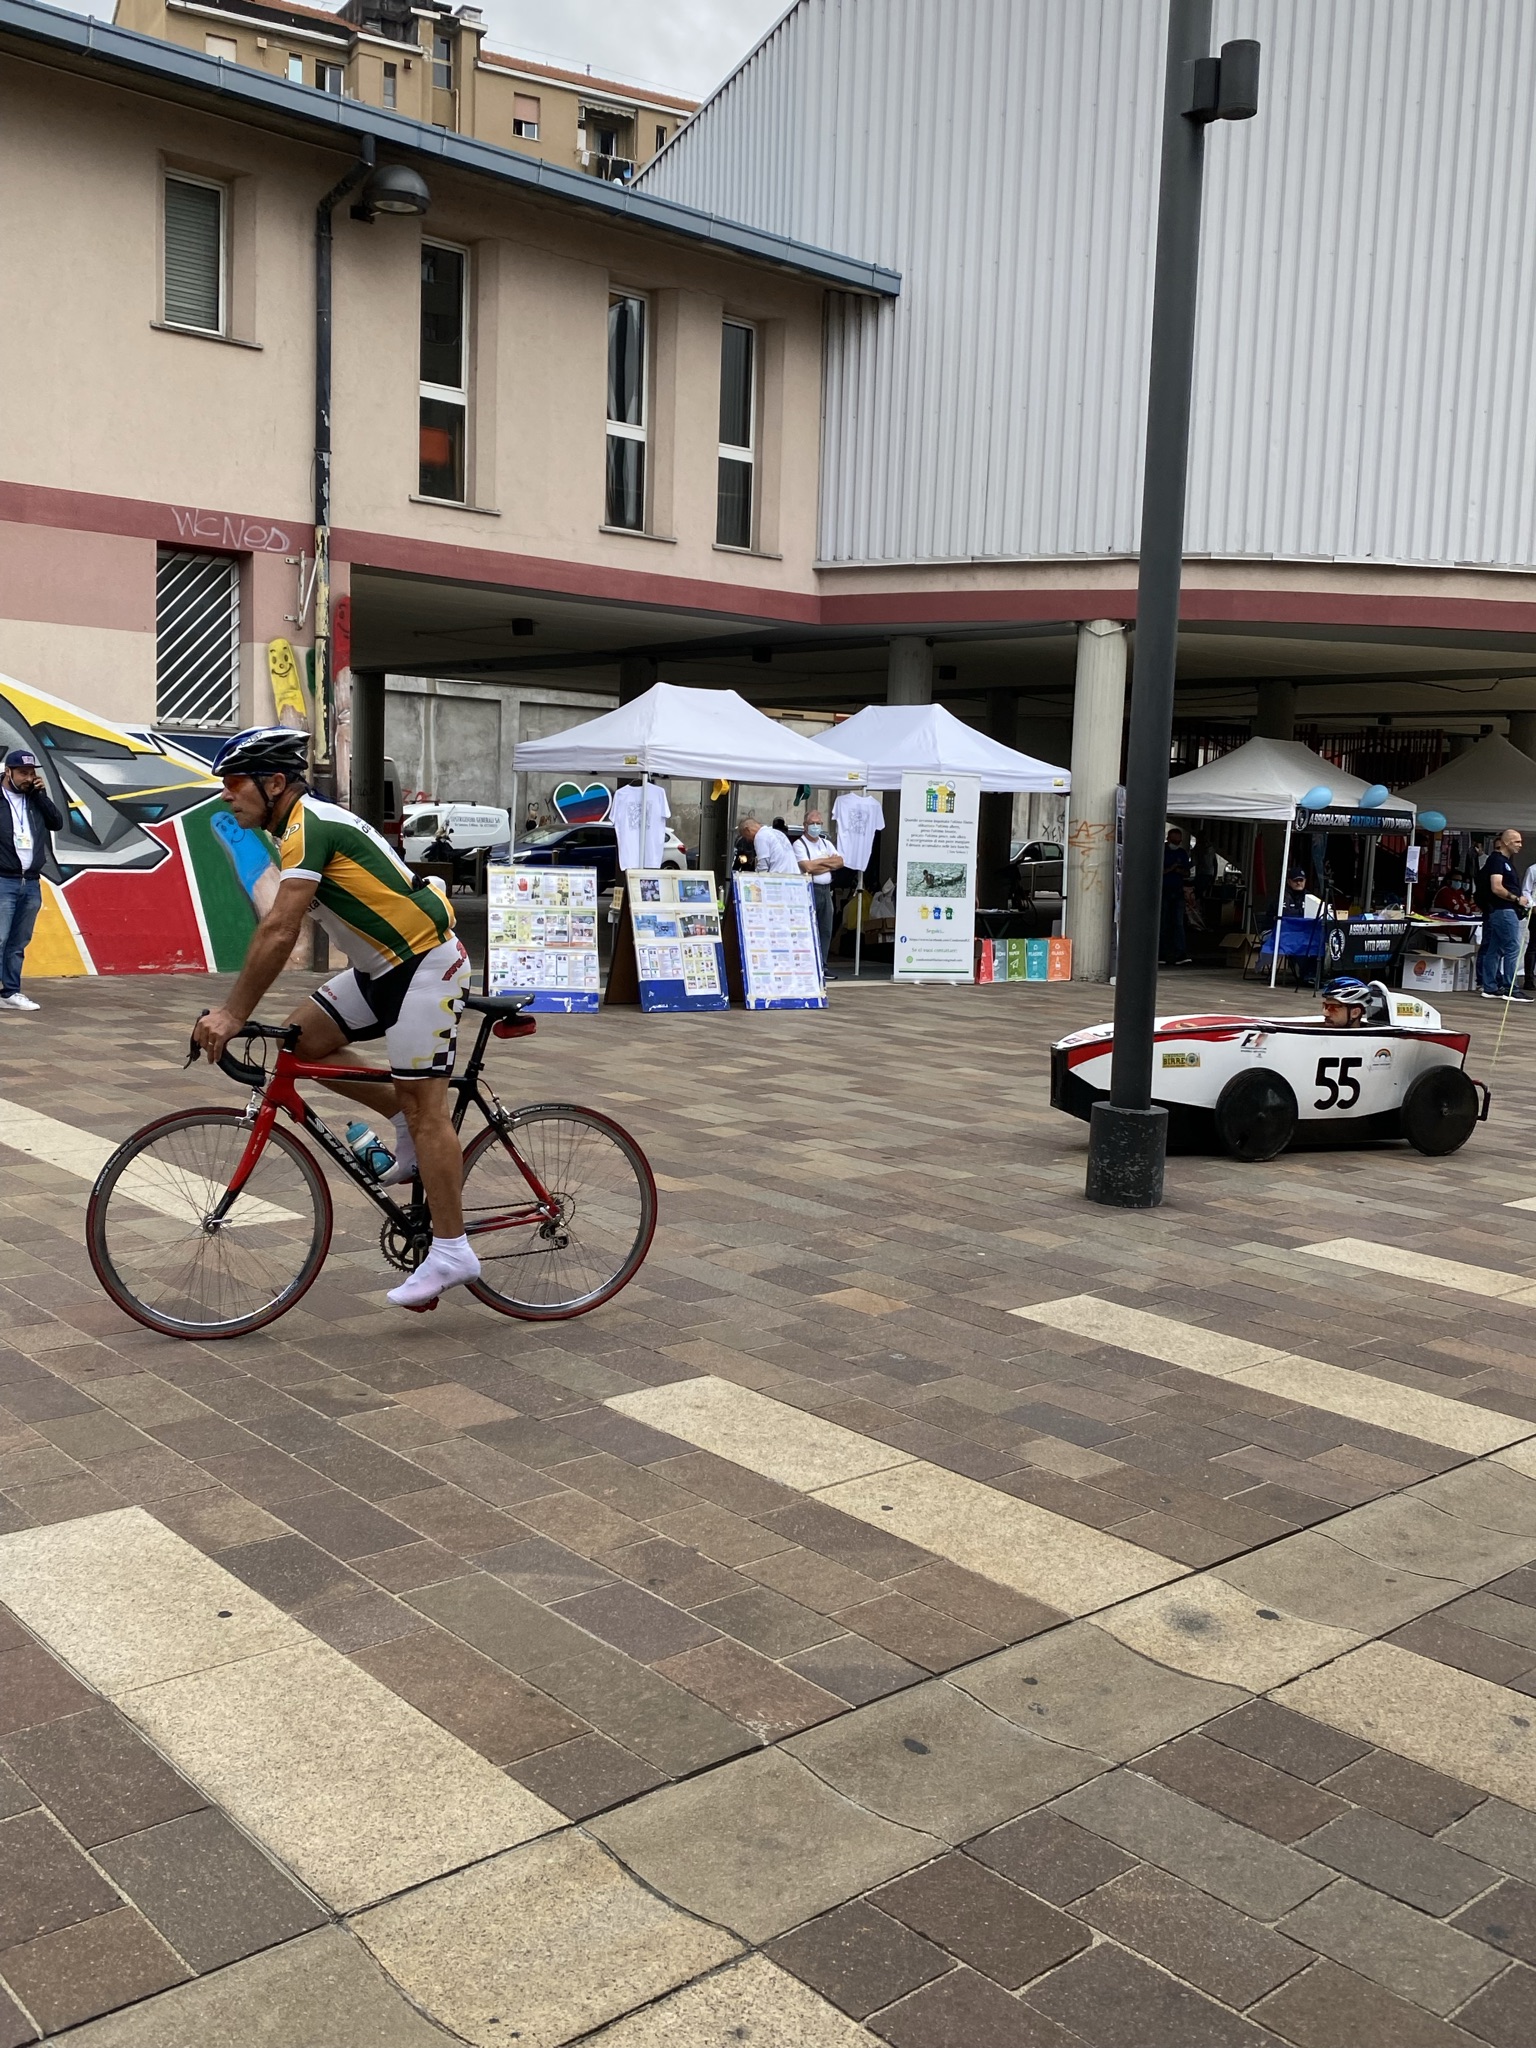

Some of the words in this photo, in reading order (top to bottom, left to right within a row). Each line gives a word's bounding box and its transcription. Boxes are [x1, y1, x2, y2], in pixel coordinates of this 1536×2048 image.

[1309, 813, 1351, 826] ASSOCIAZIONE
[1351, 815, 1381, 828] CULTURALE
[1382, 816, 1395, 829] VITO
[1349, 923, 1382, 936] ASSOCIAZIONE
[1382, 923, 1407, 935] CULTURALE
[1364, 940, 1376, 952] VITO
[1375, 939, 1391, 951] PORRO
[1163, 1057, 1186, 1065] BIRRE
[1313, 1057, 1363, 1110] 55
